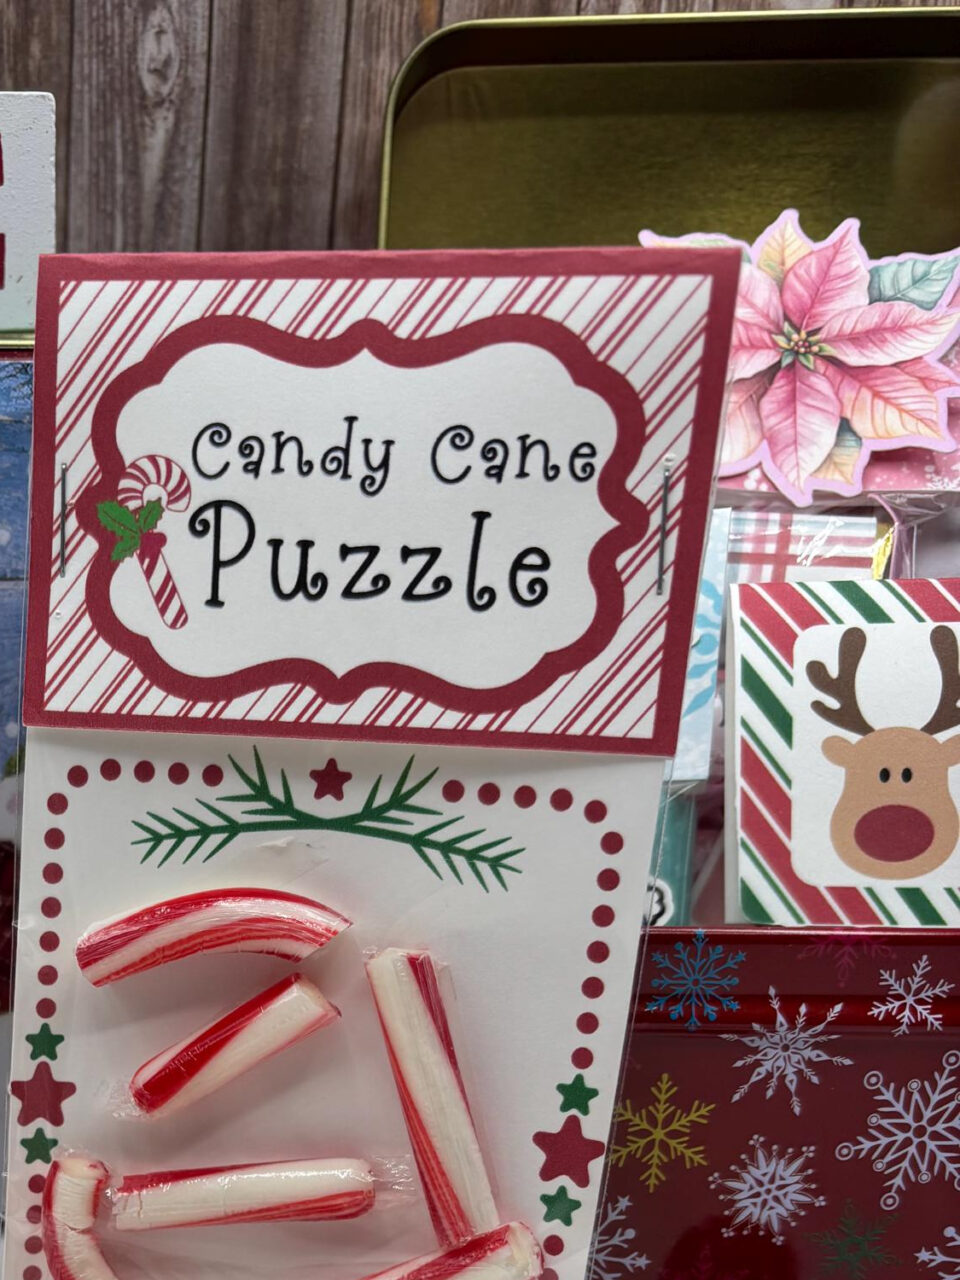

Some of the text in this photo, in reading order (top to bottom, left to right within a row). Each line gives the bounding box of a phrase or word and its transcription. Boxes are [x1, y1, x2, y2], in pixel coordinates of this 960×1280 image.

[191, 415, 597, 497] Candy Cane
[188, 499, 551, 613] Puzzle
